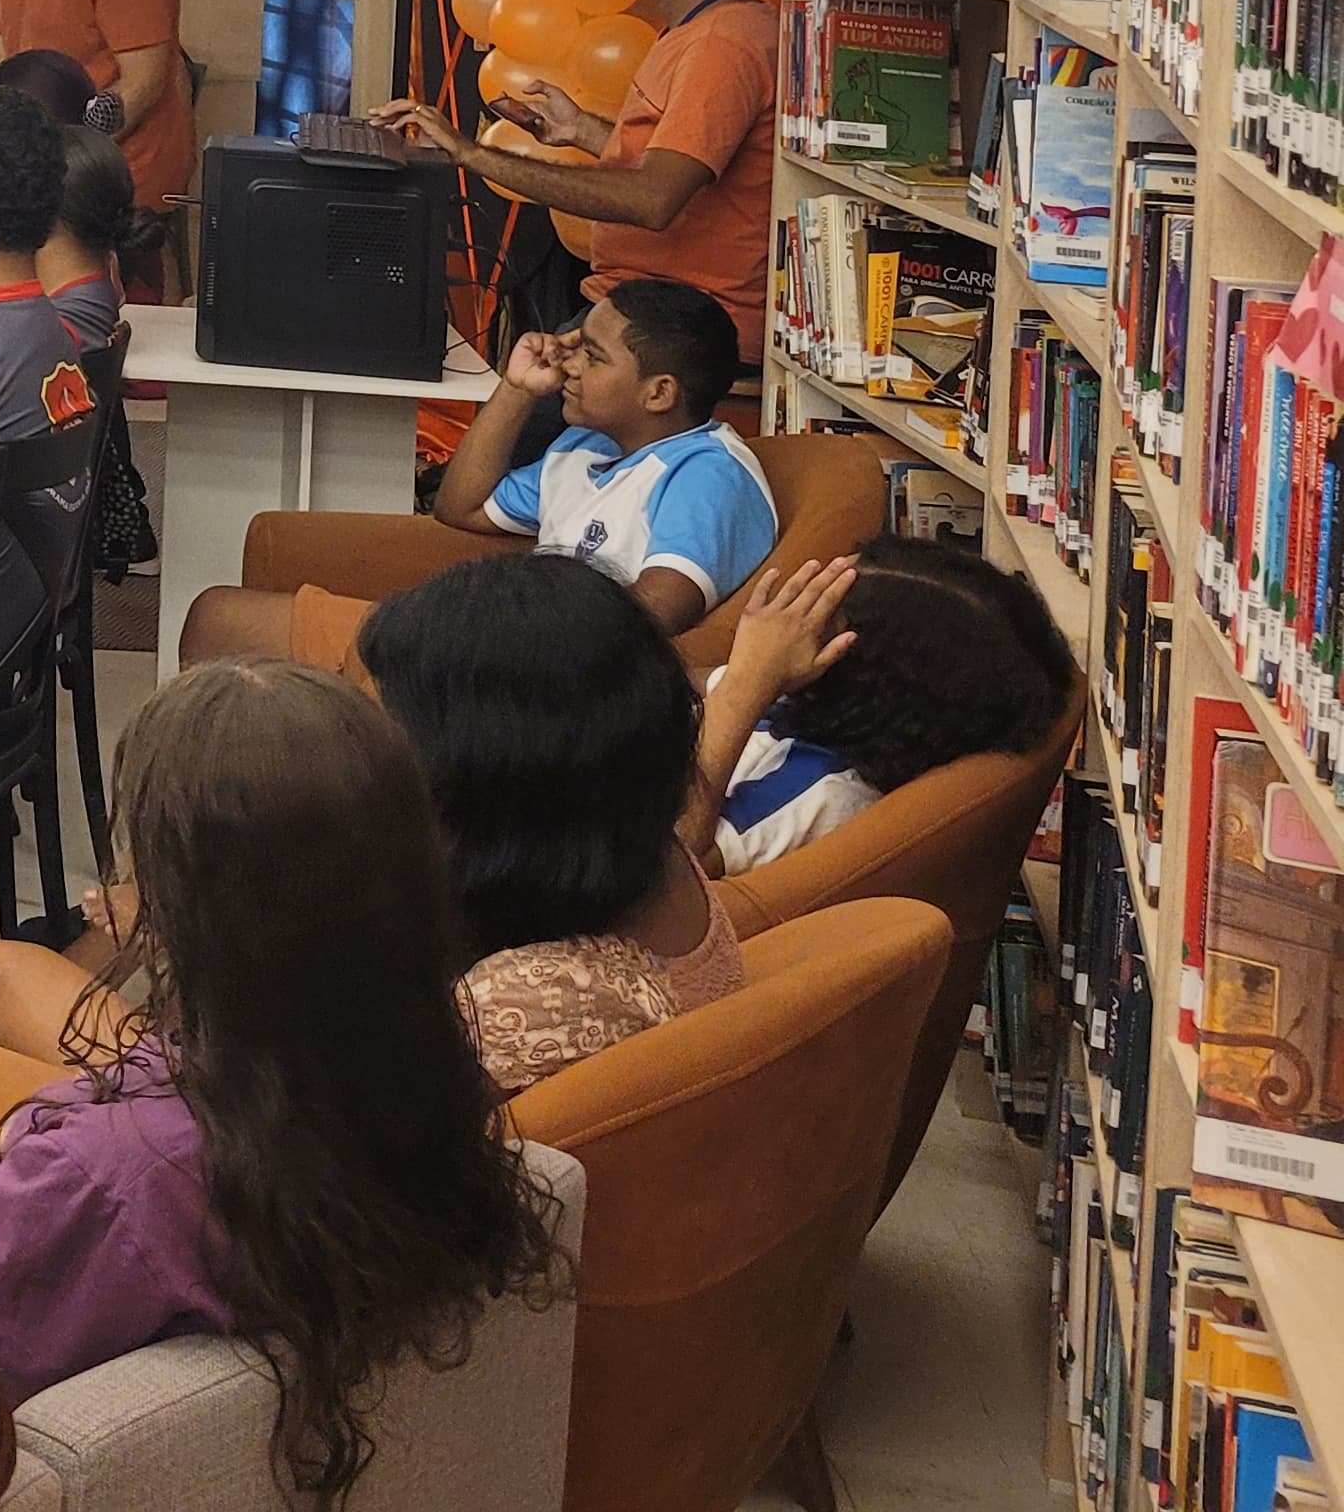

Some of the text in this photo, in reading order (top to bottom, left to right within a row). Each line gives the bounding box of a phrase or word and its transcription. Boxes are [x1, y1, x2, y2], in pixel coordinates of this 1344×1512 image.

[841, 20, 878, 30] MÉTODO
[882, 25, 928, 35] MODERNO
[841, 29, 944, 49] TUPI ANTIGO
[900, 276, 918, 285] PARA
[903, 258, 996, 289] 1001 CARR
